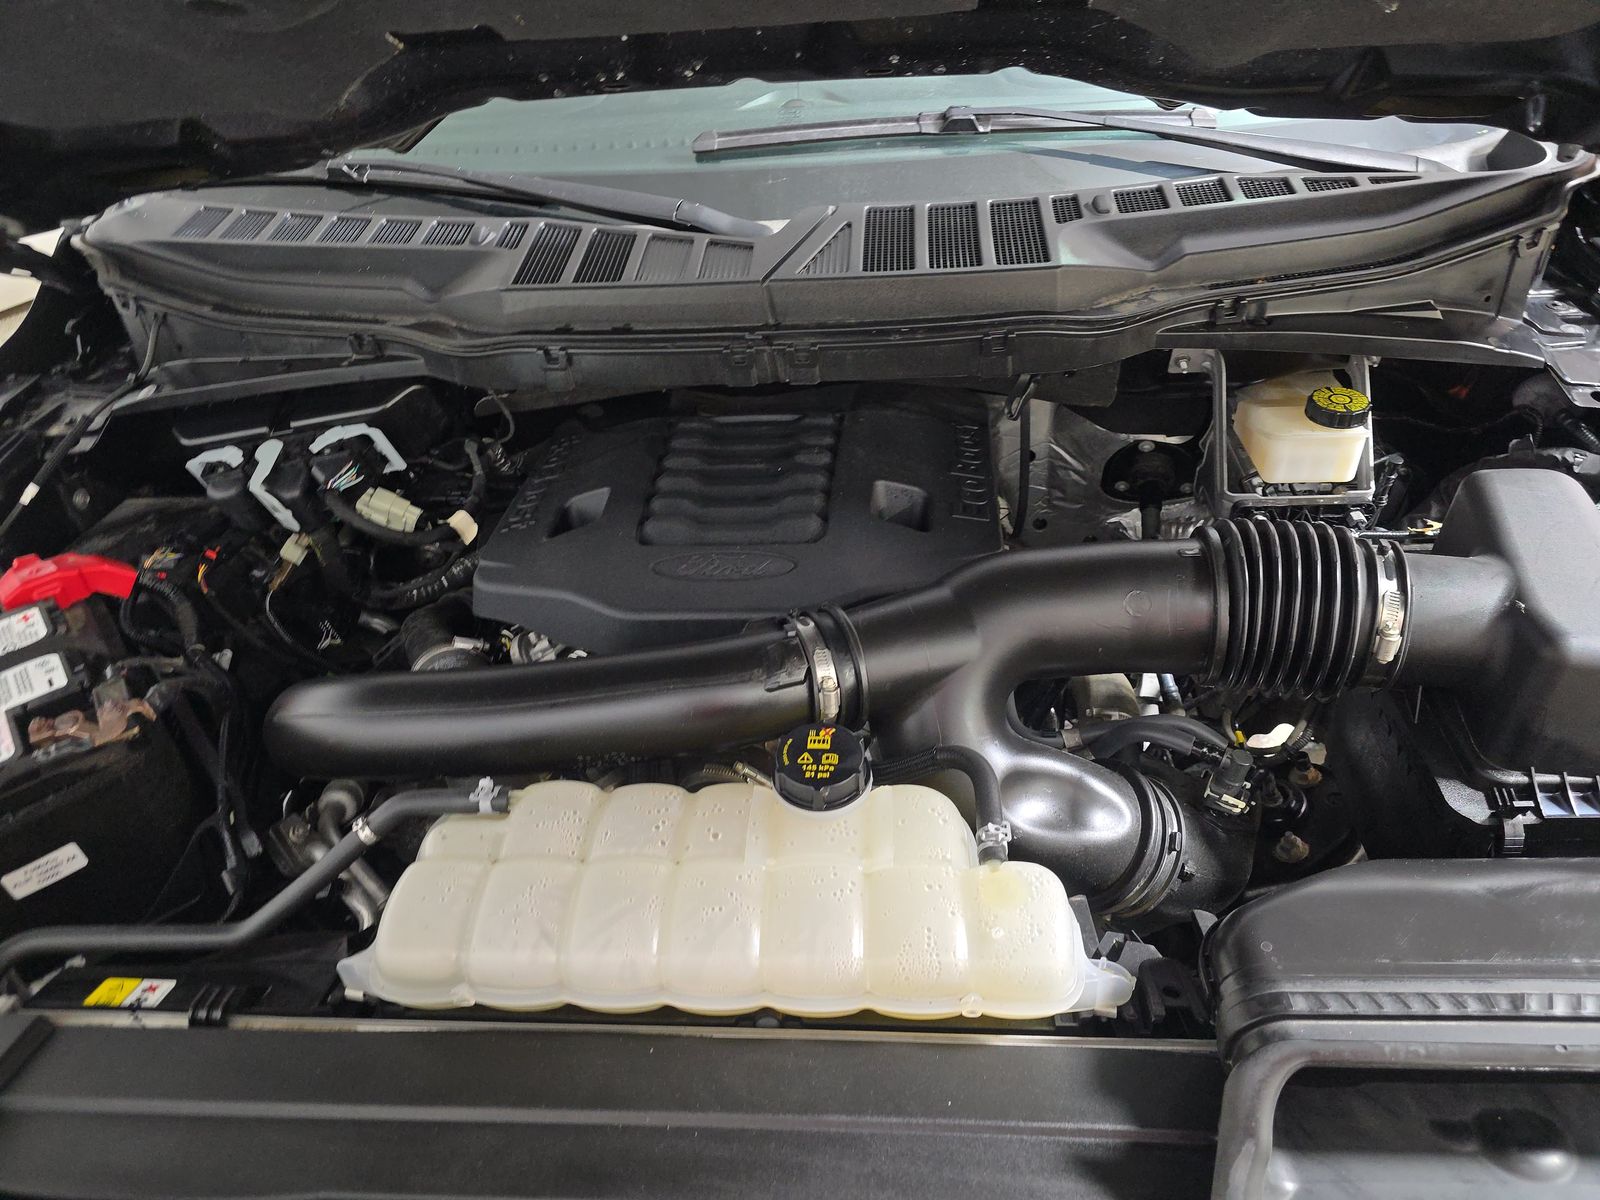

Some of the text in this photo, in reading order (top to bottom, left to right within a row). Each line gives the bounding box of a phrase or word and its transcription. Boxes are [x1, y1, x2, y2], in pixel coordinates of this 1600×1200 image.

[949, 422, 992, 523] EcoBoost
[675, 553, 773, 577] Ford
[817, 771, 830, 779] psi
[818, 764, 835, 772] kPa
